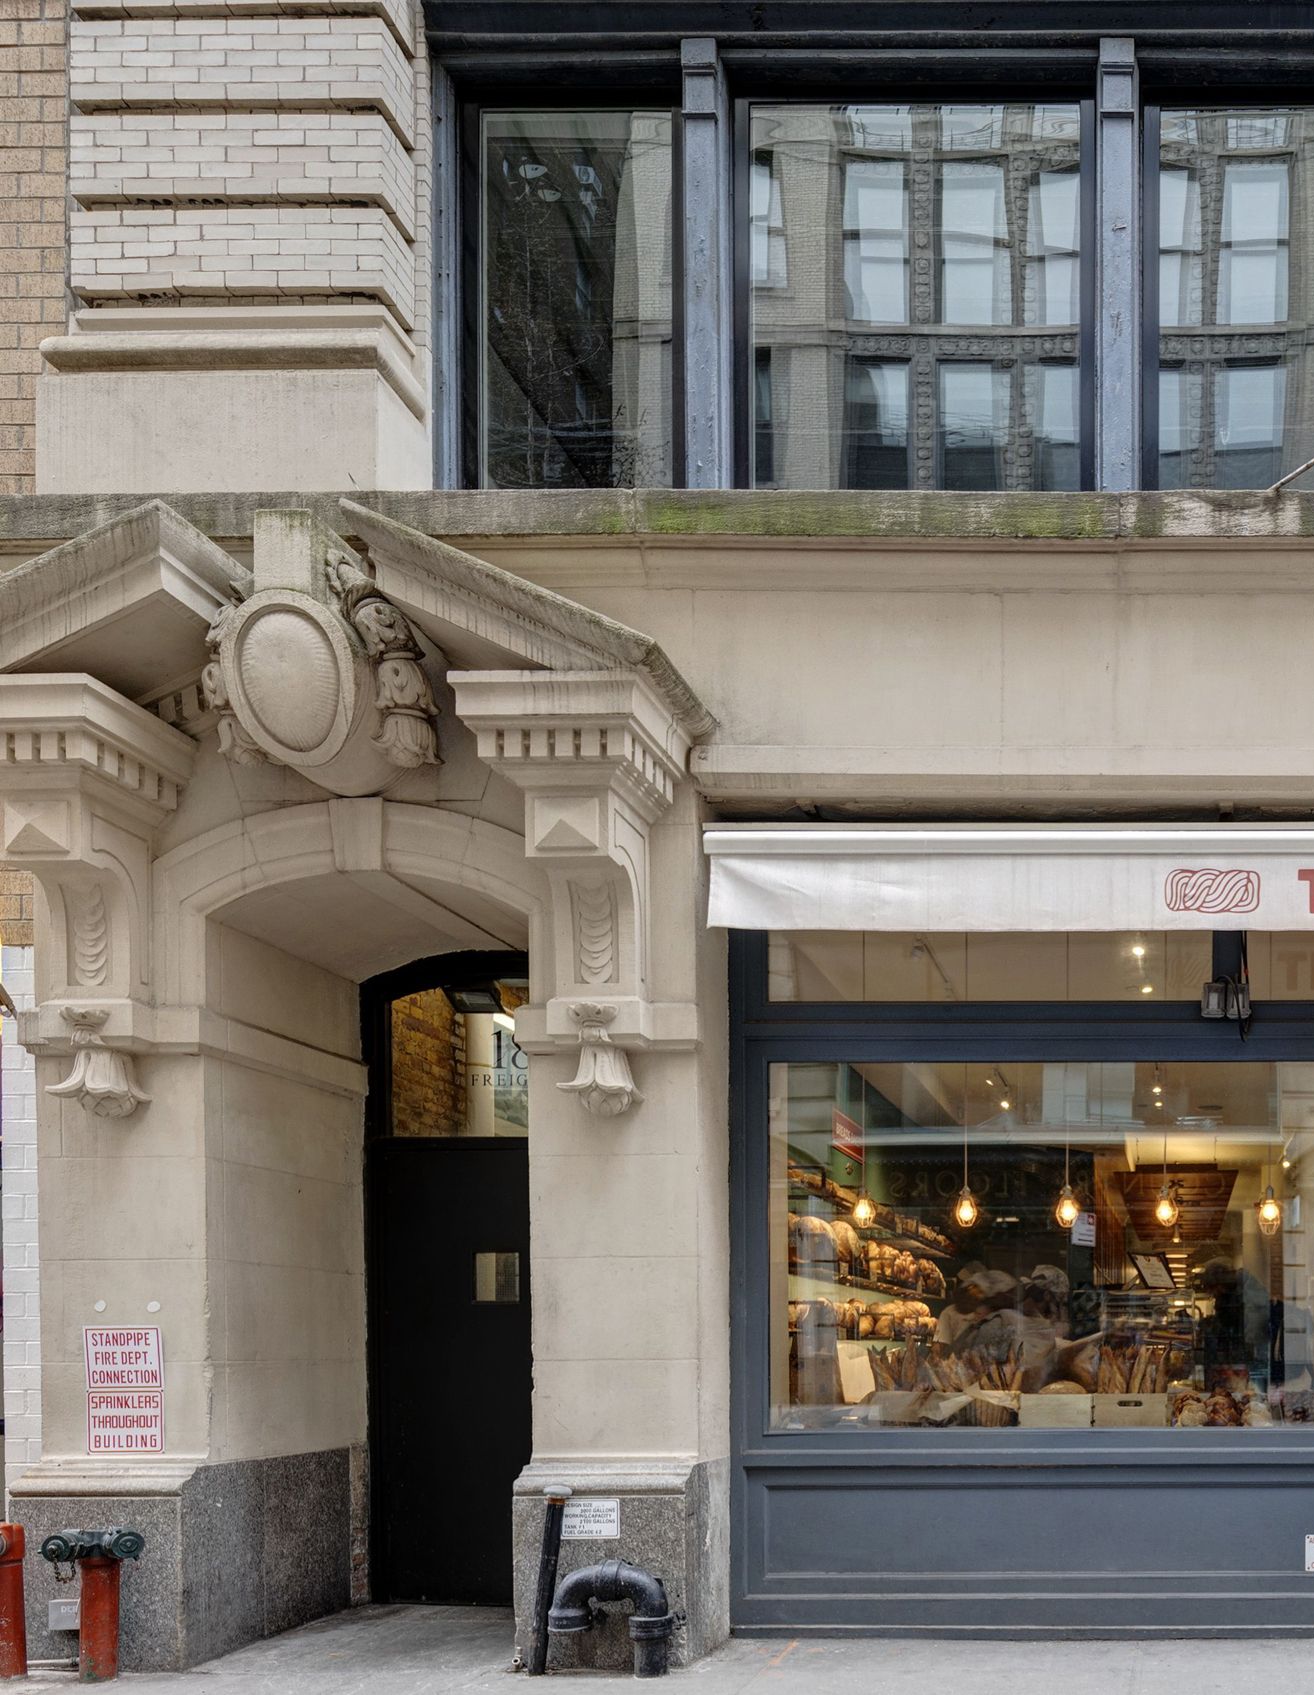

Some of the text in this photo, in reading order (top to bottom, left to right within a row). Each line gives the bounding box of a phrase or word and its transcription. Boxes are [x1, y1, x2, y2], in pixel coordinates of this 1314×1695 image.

[91, 1332, 151, 1347] STANDPIPE
[95, 1350, 152, 1365] FIRE DEPT.
[92, 1369, 158, 1384] CONNECTION
[91, 1395, 159, 1409] SPRINKLERS
[91, 1414, 159, 1428] THROUGHOUT
[94, 1434, 157, 1448] BUILDING
